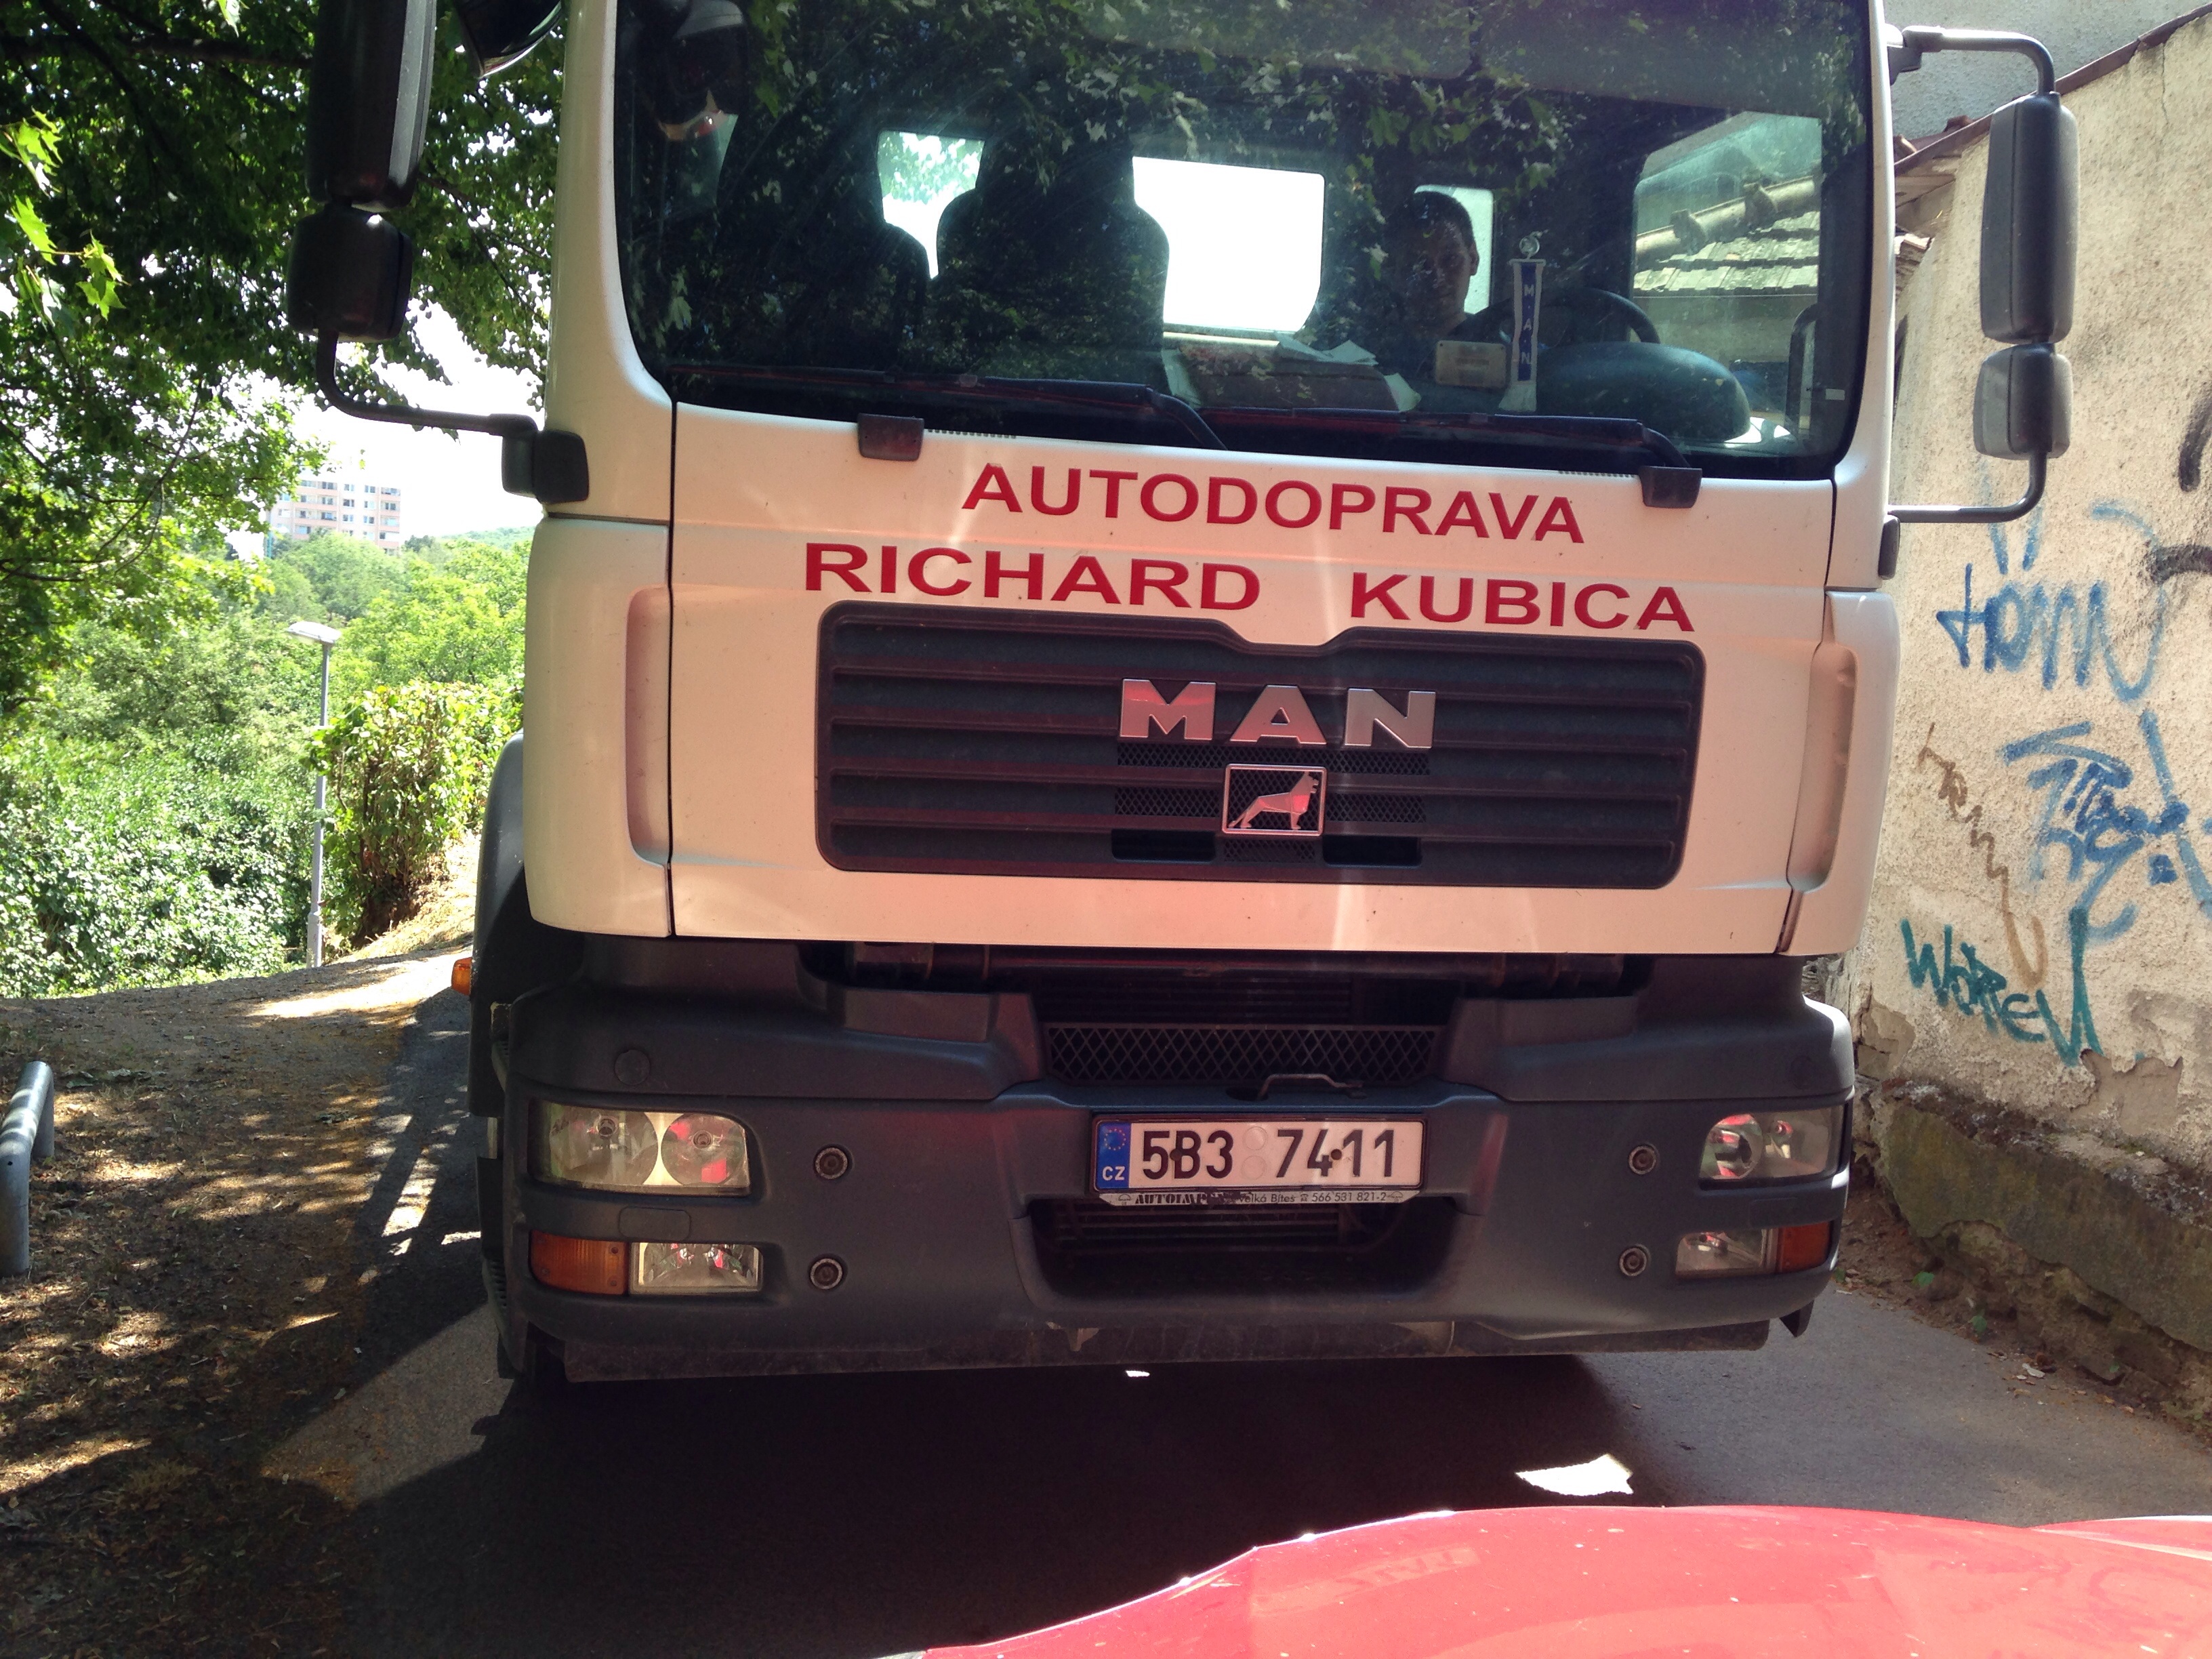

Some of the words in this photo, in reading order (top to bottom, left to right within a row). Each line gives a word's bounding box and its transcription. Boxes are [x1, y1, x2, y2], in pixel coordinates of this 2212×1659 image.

[962, 464, 1584, 544] AUTODOPRAVA
[806, 543, 1260, 610] RICHARD
[1351, 573, 1694, 632] KUBICA
[1120, 678, 1436, 749] MAN
[1103, 1166, 1125, 1181] CZ
[1143, 1130, 1233, 1180] 5B3
[1276, 1129, 1395, 1178] 7411
[1311, 1191, 1332, 1202] 566
[1334, 1191, 1353, 1202] 531
[1357, 1191, 1387, 1202] 821-2
